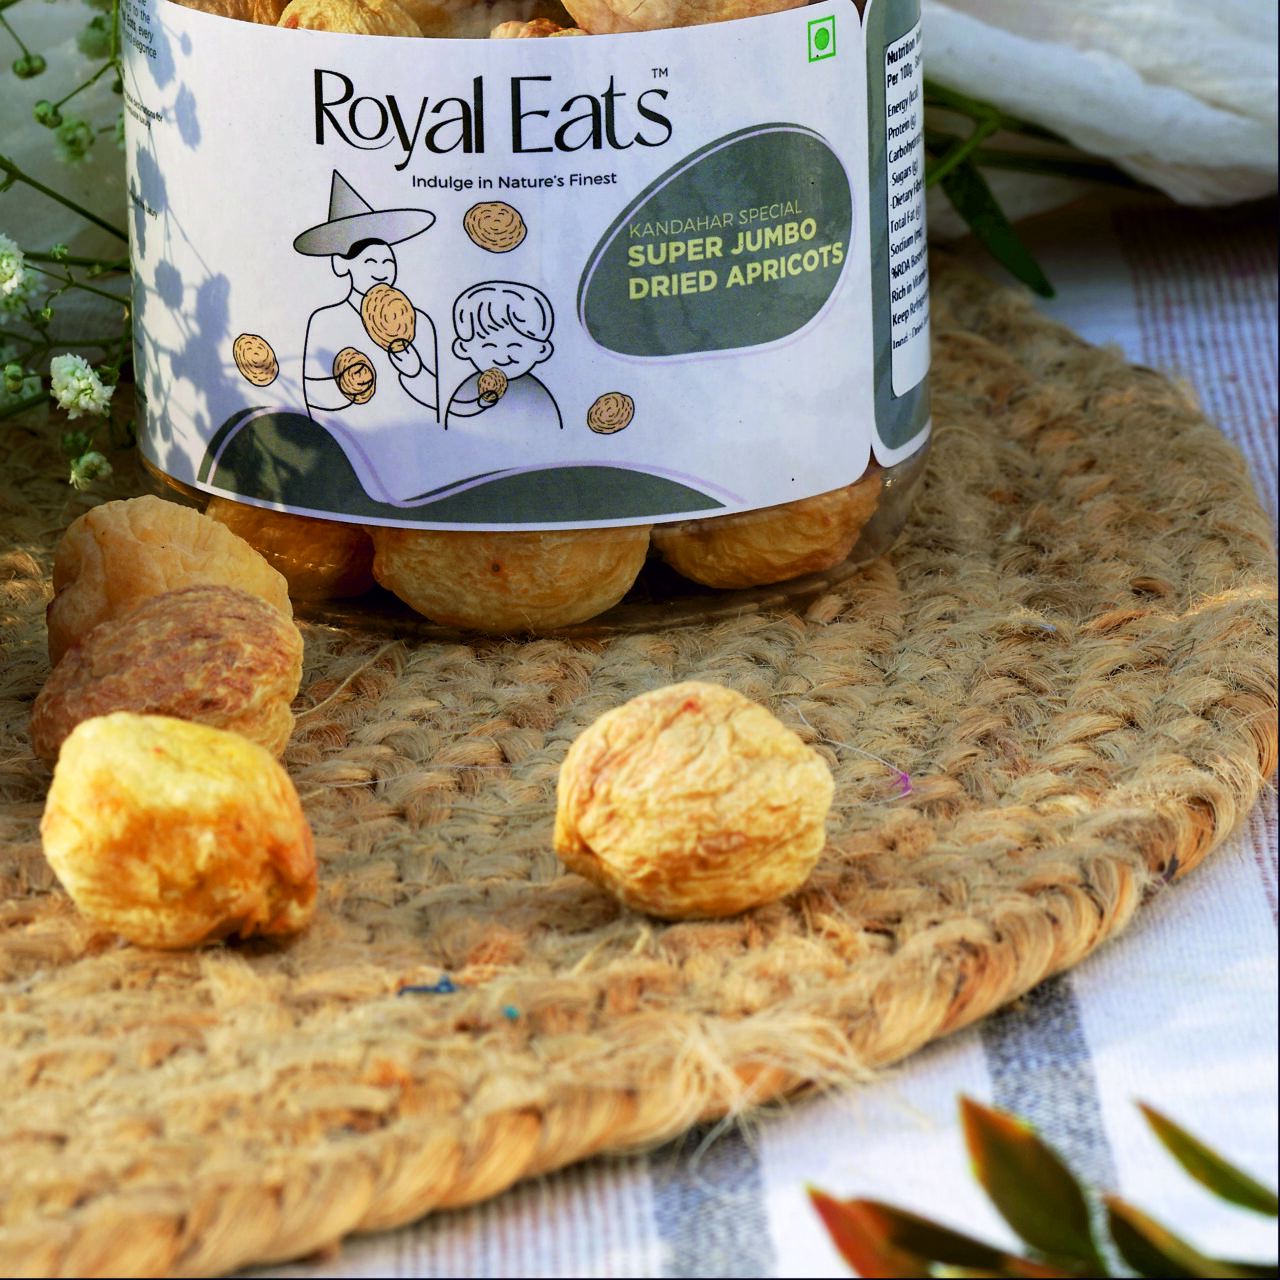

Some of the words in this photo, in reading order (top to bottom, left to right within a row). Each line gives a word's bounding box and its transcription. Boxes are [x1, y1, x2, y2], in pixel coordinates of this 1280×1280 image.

[140, 9, 151, 25] the
[138, 25, 154, 44] every
[887, 38, 916, 66] Nutrition
[887, 73, 899, 89] Per
[887, 97, 909, 118] Energy
[315, 68, 485, 172] Royal
[510, 75, 673, 154] Eats
[888, 117, 911, 140] Protein
[411, 174, 474, 190] Indulge
[477, 175, 494, 190] in
[498, 174, 566, 190] Nature's
[569, 172, 618, 187] Finest
[629, 212, 734, 238] KANDAHAR
[738, 199, 803, 225] SPECIAL
[890, 212, 907, 234] Total
[627, 235, 724, 268] SUPER
[730, 217, 817, 256] JUMBO
[890, 236, 914, 258] Sodium
[628, 269, 719, 300] DRIED
[725, 241, 844, 289] APRICOTS
[891, 284, 907, 304] Rich
[892, 309, 910, 327] Keep
